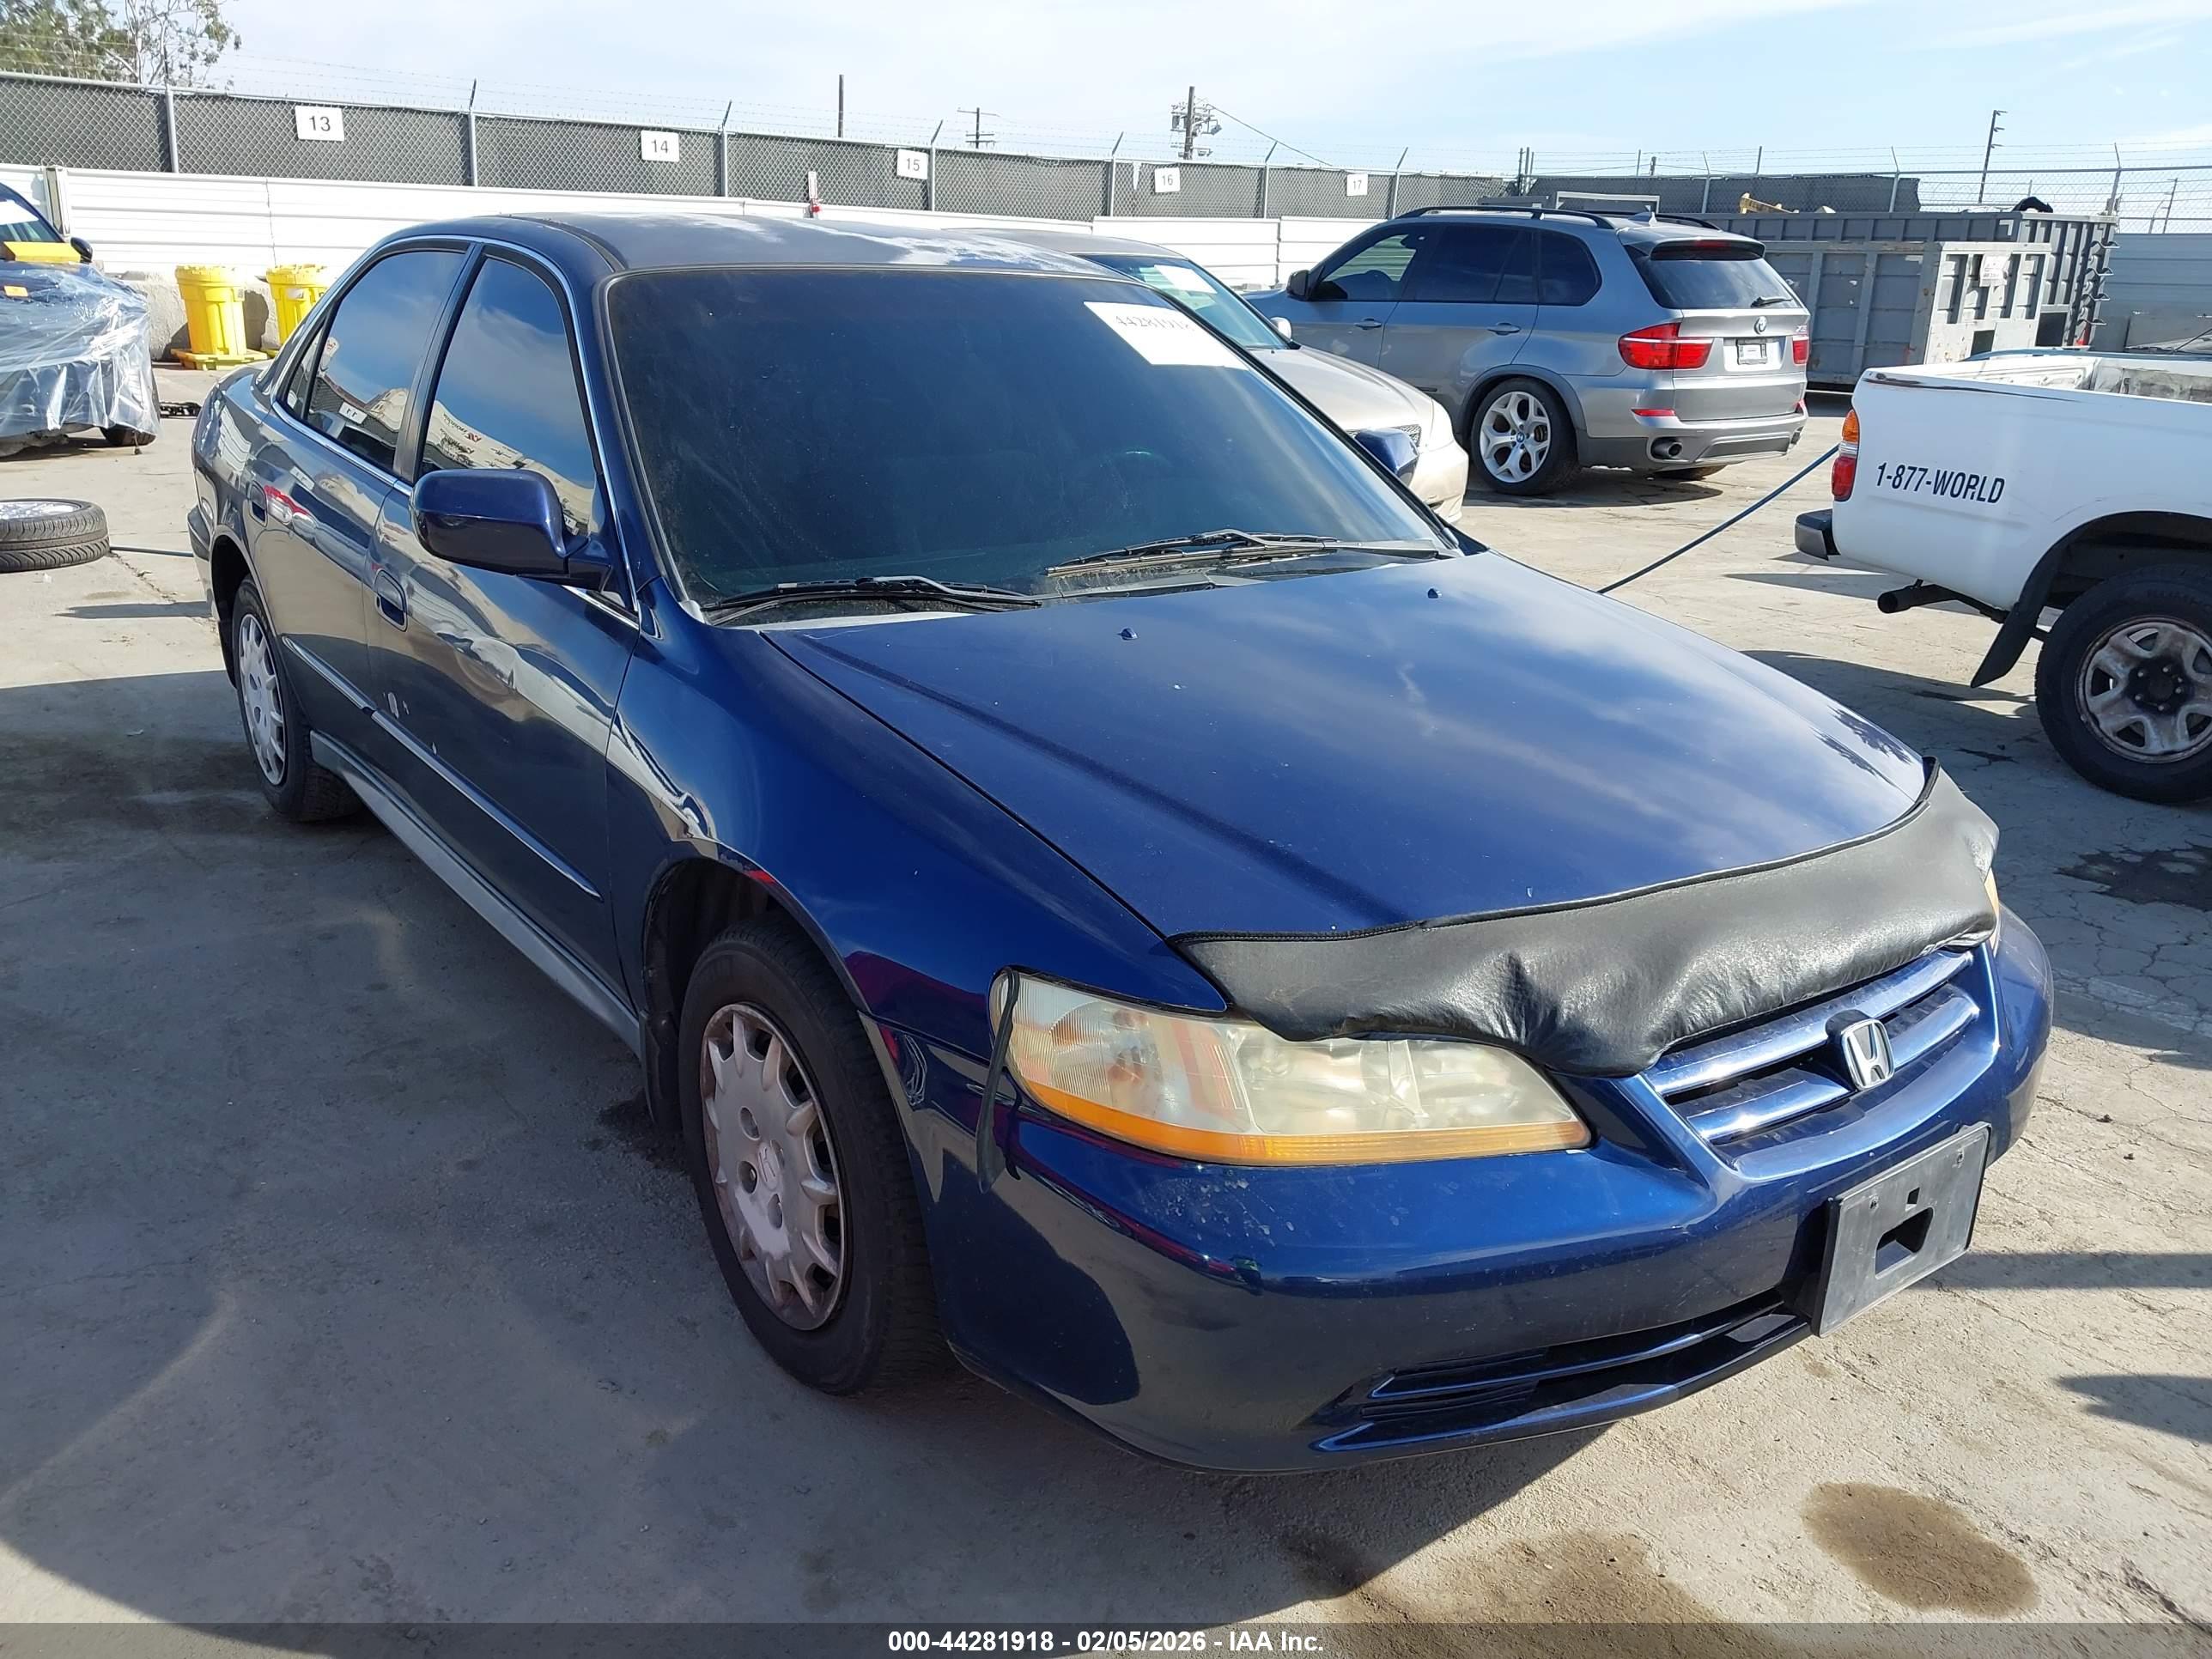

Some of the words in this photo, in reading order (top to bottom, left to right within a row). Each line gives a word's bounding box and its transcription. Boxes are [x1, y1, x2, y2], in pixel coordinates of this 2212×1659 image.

[309, 115, 331, 132] 13
[651, 139, 669, 154] 14
[907, 157, 921, 172] 15
[1161, 173, 1174, 186] 16
[1352, 179, 1363, 191] 17
[1876, 462, 2005, 504] 1-877-WORLD
